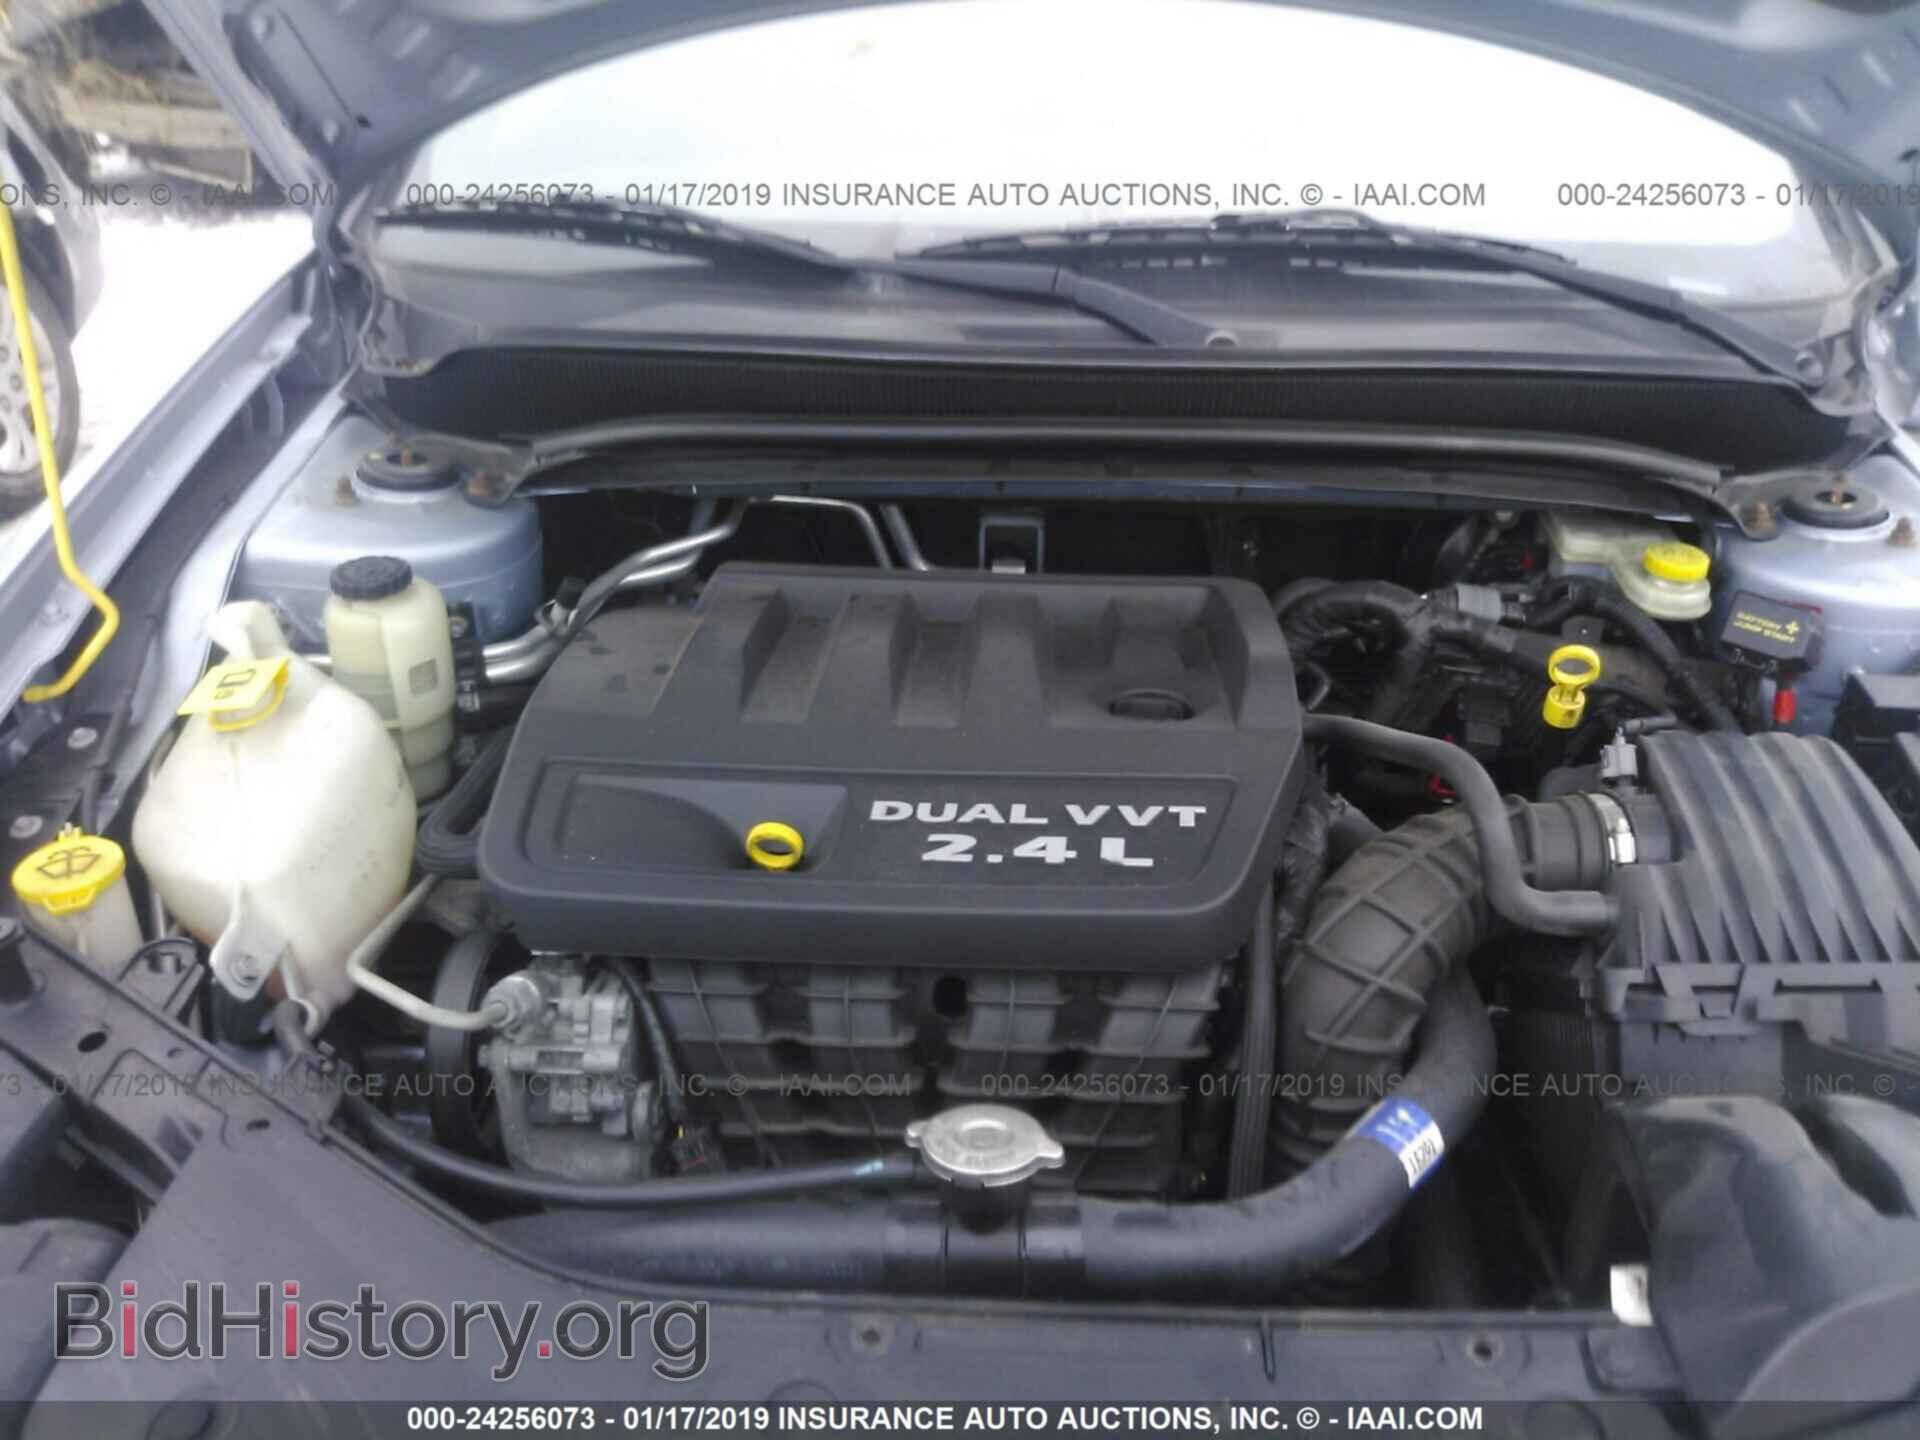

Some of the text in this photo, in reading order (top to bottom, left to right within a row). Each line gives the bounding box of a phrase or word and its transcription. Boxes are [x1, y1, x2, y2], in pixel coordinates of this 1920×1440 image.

[869, 800, 1207, 828] DUAL VVT
[921, 833, 1154, 867] 2.4 L
